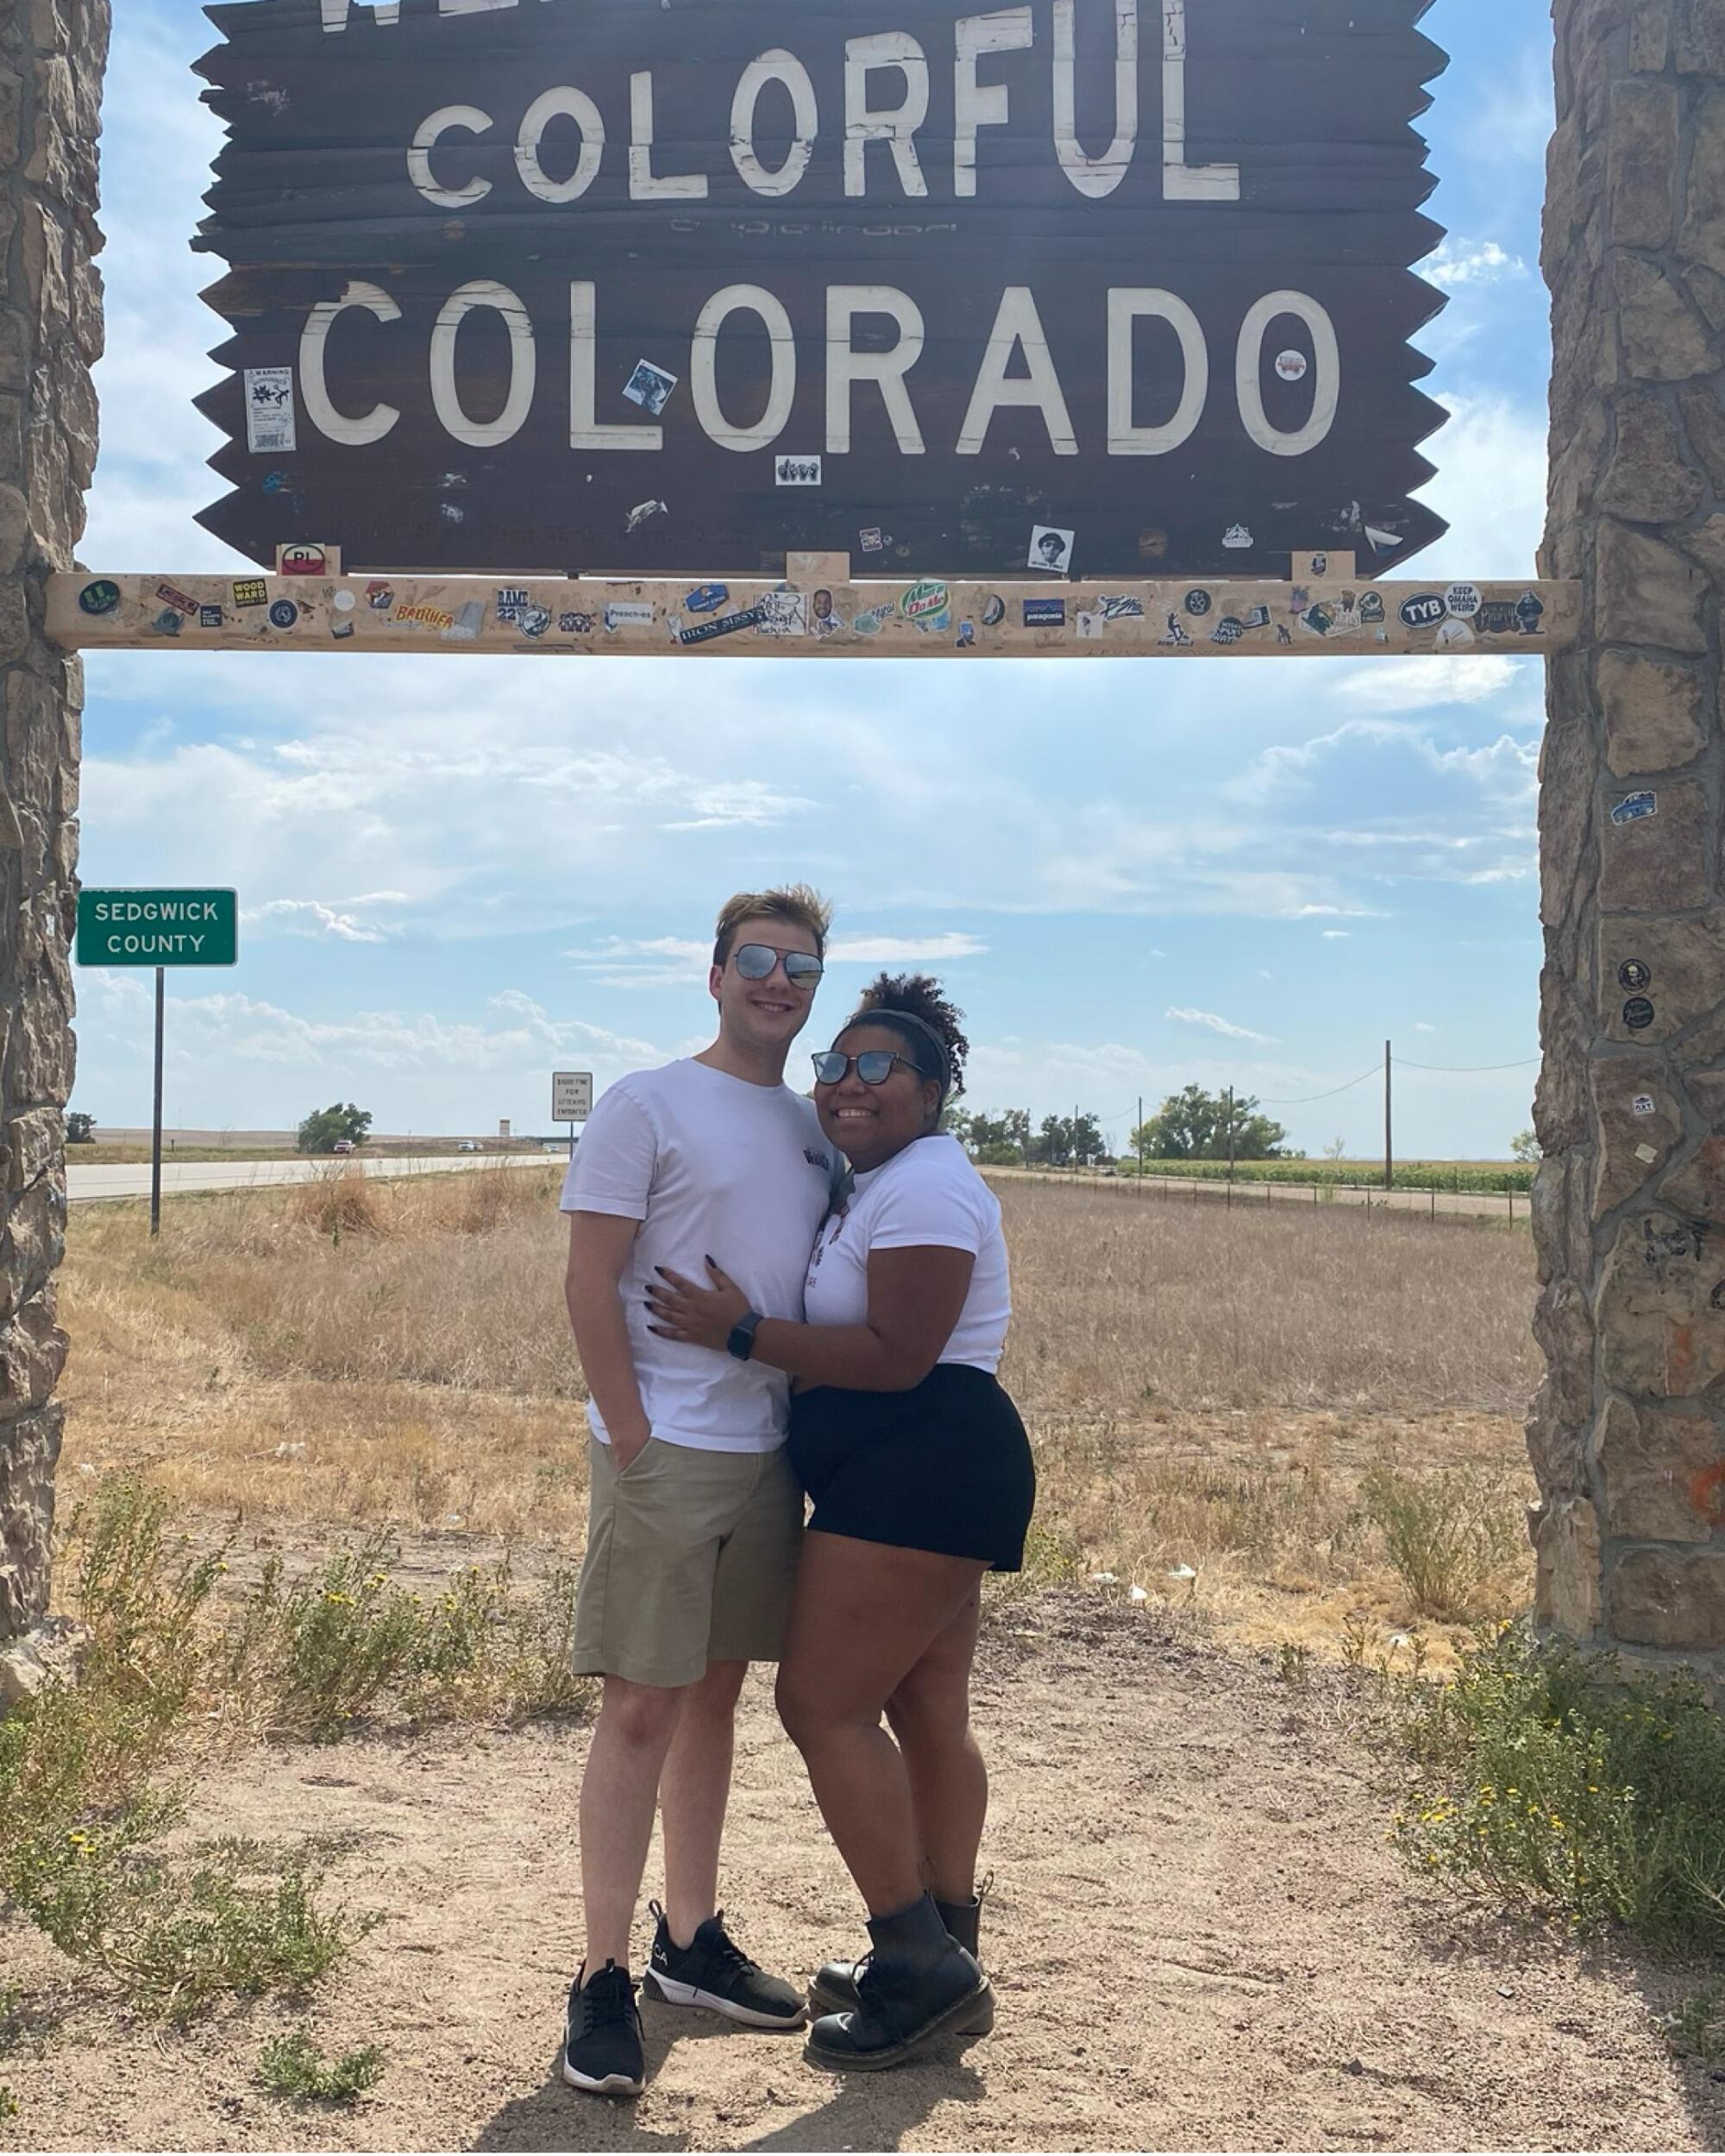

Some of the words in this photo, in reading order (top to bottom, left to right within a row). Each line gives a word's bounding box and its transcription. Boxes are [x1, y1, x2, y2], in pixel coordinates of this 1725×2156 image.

[407, 0, 1240, 207] COLORFUL
[298, 279, 1339, 456] COLORADO
[293, 551, 313, 566] PL
[234, 580, 264, 592] WOOD
[1452, 586, 1473, 595] KEEP
[235, 589, 266, 601] WARD
[1447, 593, 1477, 605] OMAHA
[1027, 611, 1063, 621] patagonia
[1406, 599, 1442, 622] TYB
[682, 622, 718, 640] IRON
[95, 902, 218, 921] SEDGWICK
[106, 934, 206, 953] COUNTY
